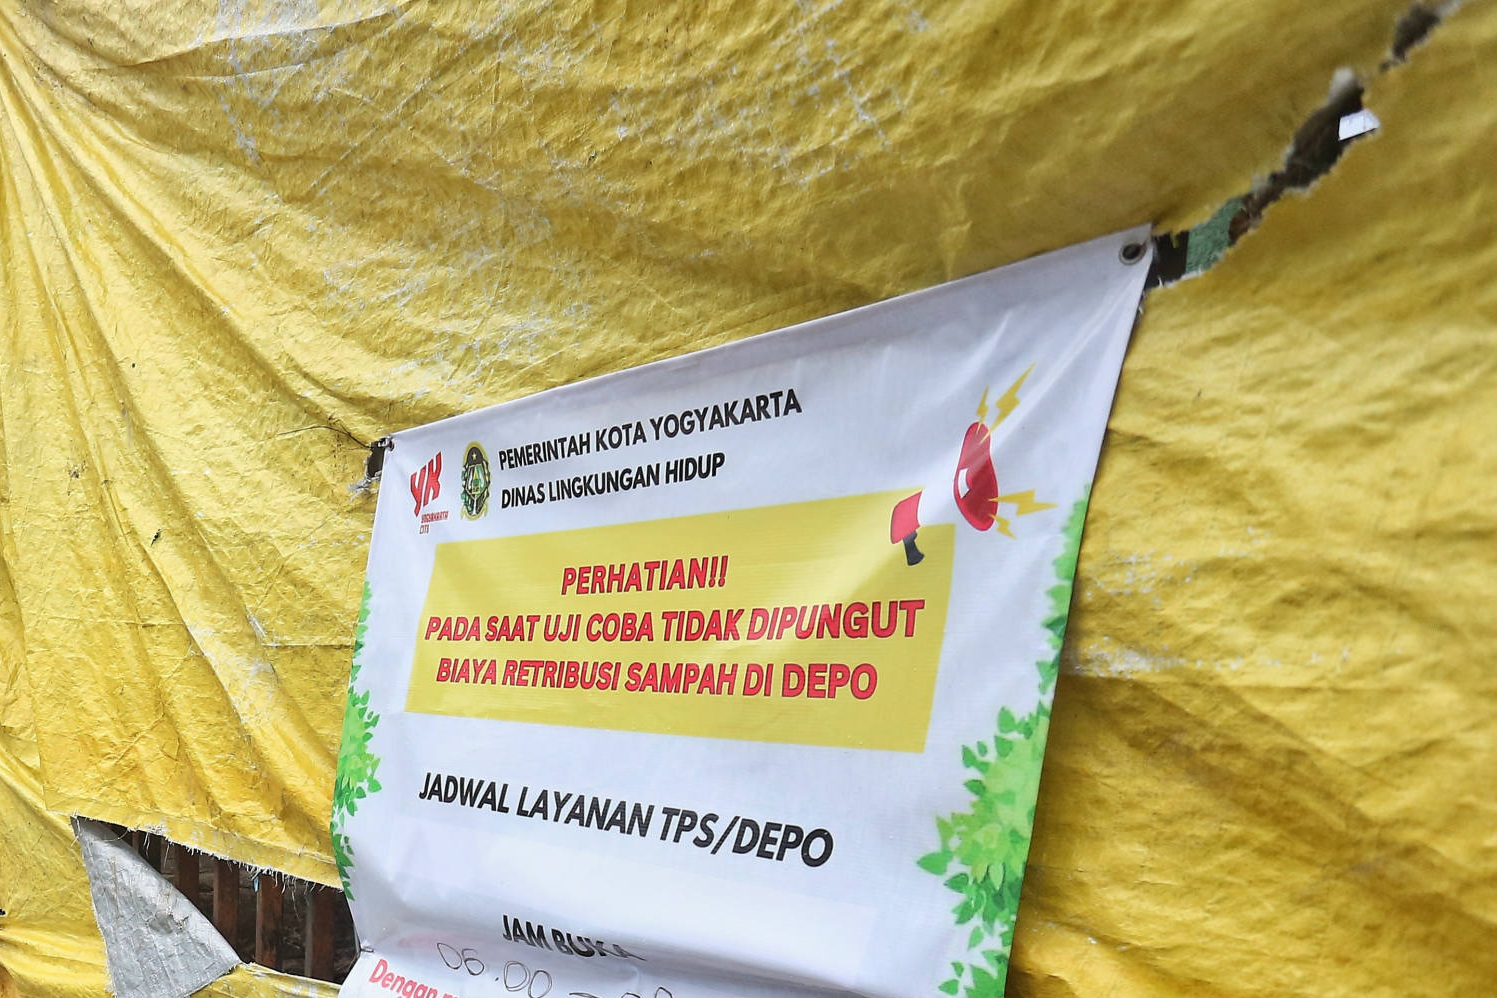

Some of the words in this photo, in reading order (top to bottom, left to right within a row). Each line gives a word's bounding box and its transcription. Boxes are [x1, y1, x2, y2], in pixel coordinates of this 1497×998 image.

[498, 432, 591, 471] PEMERINTAH
[595, 421, 647, 453] KOTA
[650, 388, 802, 441] YOGYAKARTA
[501, 483, 546, 509] DINAS
[548, 463, 660, 502] LINGKUNGAN
[665, 451, 725, 484] HIDUP
[561, 555, 729, 596] PERHATIAN!!
[424, 616, 482, 641] PADA
[484, 614, 541, 642] SAAT
[543, 614, 579, 642] UJI
[585, 611, 653, 642] COBA
[661, 609, 745, 642] TIDAK
[746, 599, 925, 642] DIPUNGUT
[436, 657, 496, 686] BIAYA
[502, 659, 621, 691] RETRIBUSI
[624, 662, 738, 696] SAMPAH
[742, 664, 773, 698] DI
[781, 663, 879, 700] DEPO
[418, 772, 510, 814] JADWAL
[516, 785, 655, 838] LAYANAN
[659, 806, 834, 868] TPS/DEPO
[502, 914, 550, 951] JAM
